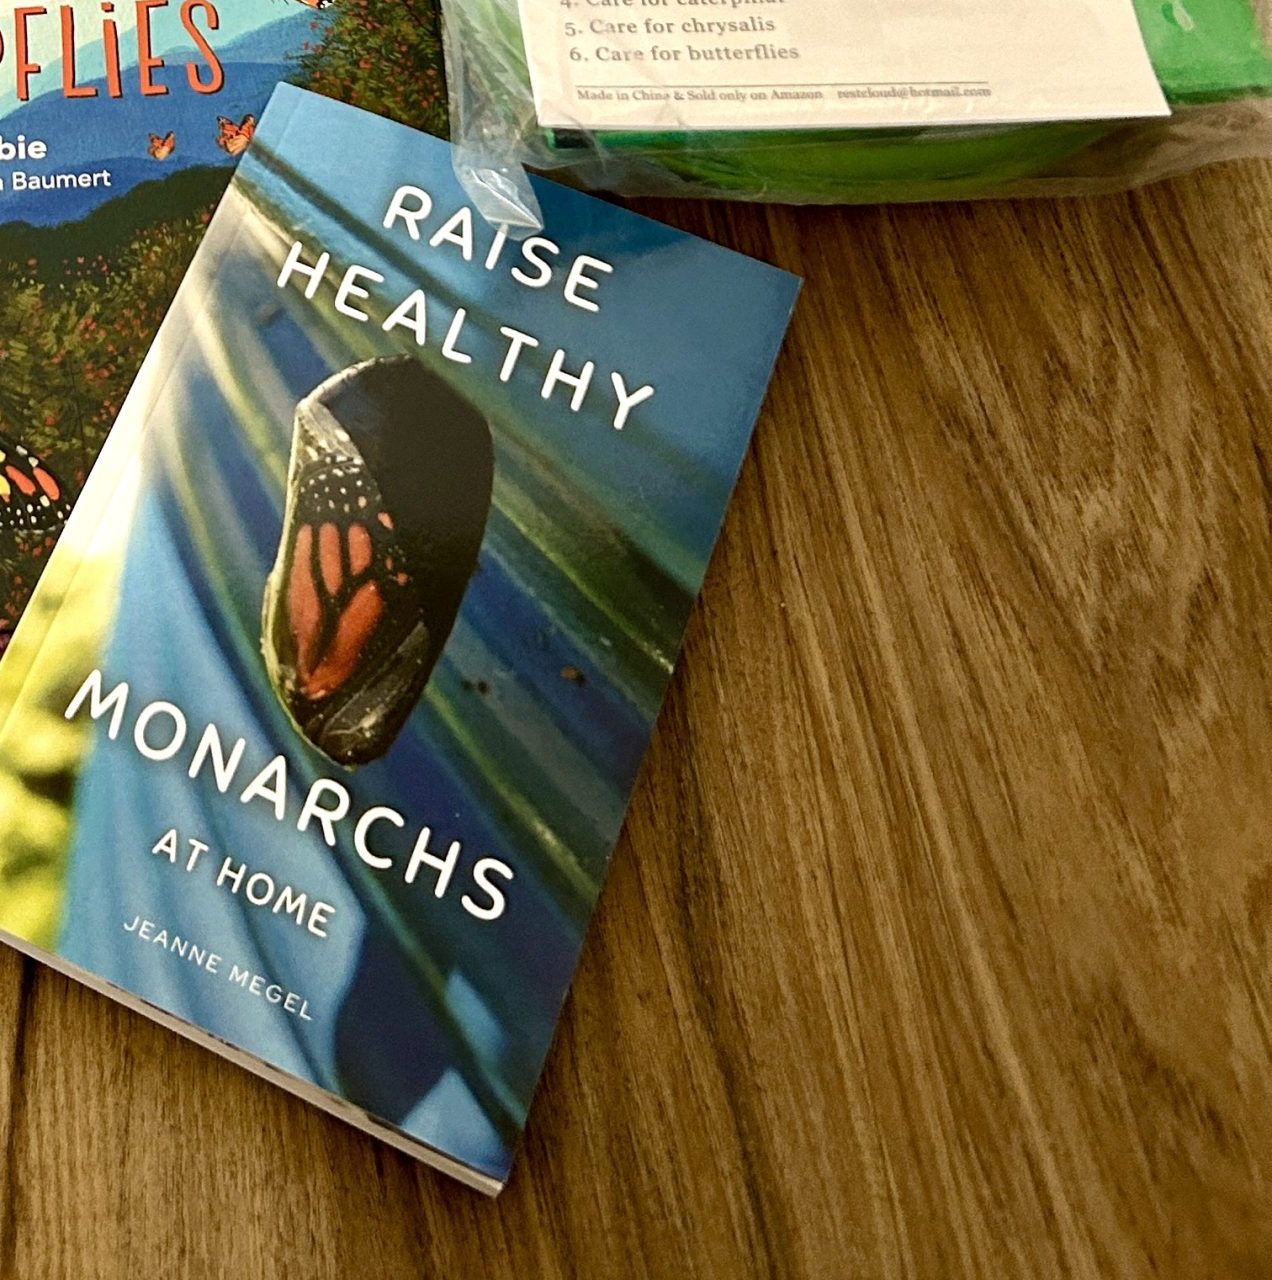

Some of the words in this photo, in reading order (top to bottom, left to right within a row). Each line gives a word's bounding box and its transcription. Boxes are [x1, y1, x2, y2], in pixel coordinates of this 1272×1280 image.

[564, 21, 583, 37] 5.
[590, 19, 638, 35] Care
[644, 17, 675, 34] for
[681, 16, 776, 36] chrysalis
[569, 45, 588, 62] 6.
[595, 46, 644, 62] Care
[651, 45, 681, 61] for
[687, 43, 800, 62] butterflies
[576, 88, 614, 102] Made
[617, 89, 629, 101] in
[632, 87, 670, 102] China
[673, 89, 684, 101] &
[687, 87, 716, 101] Sold
[718, 88, 746, 104] only
[750, 90, 767, 101] on
[771, 88, 824, 101] Amazon
[12, 169, 112, 192] Baumert
[383, 184, 614, 313] RAISE
[276, 240, 655, 431] HEALTHY
[64, 669, 515, 921] MONARCHS
[152, 829, 209, 872] AT
[216, 856, 336, 938] HOME
[123, 915, 222, 974] JEANNE
[228, 964, 312, 1022] MEGEL
